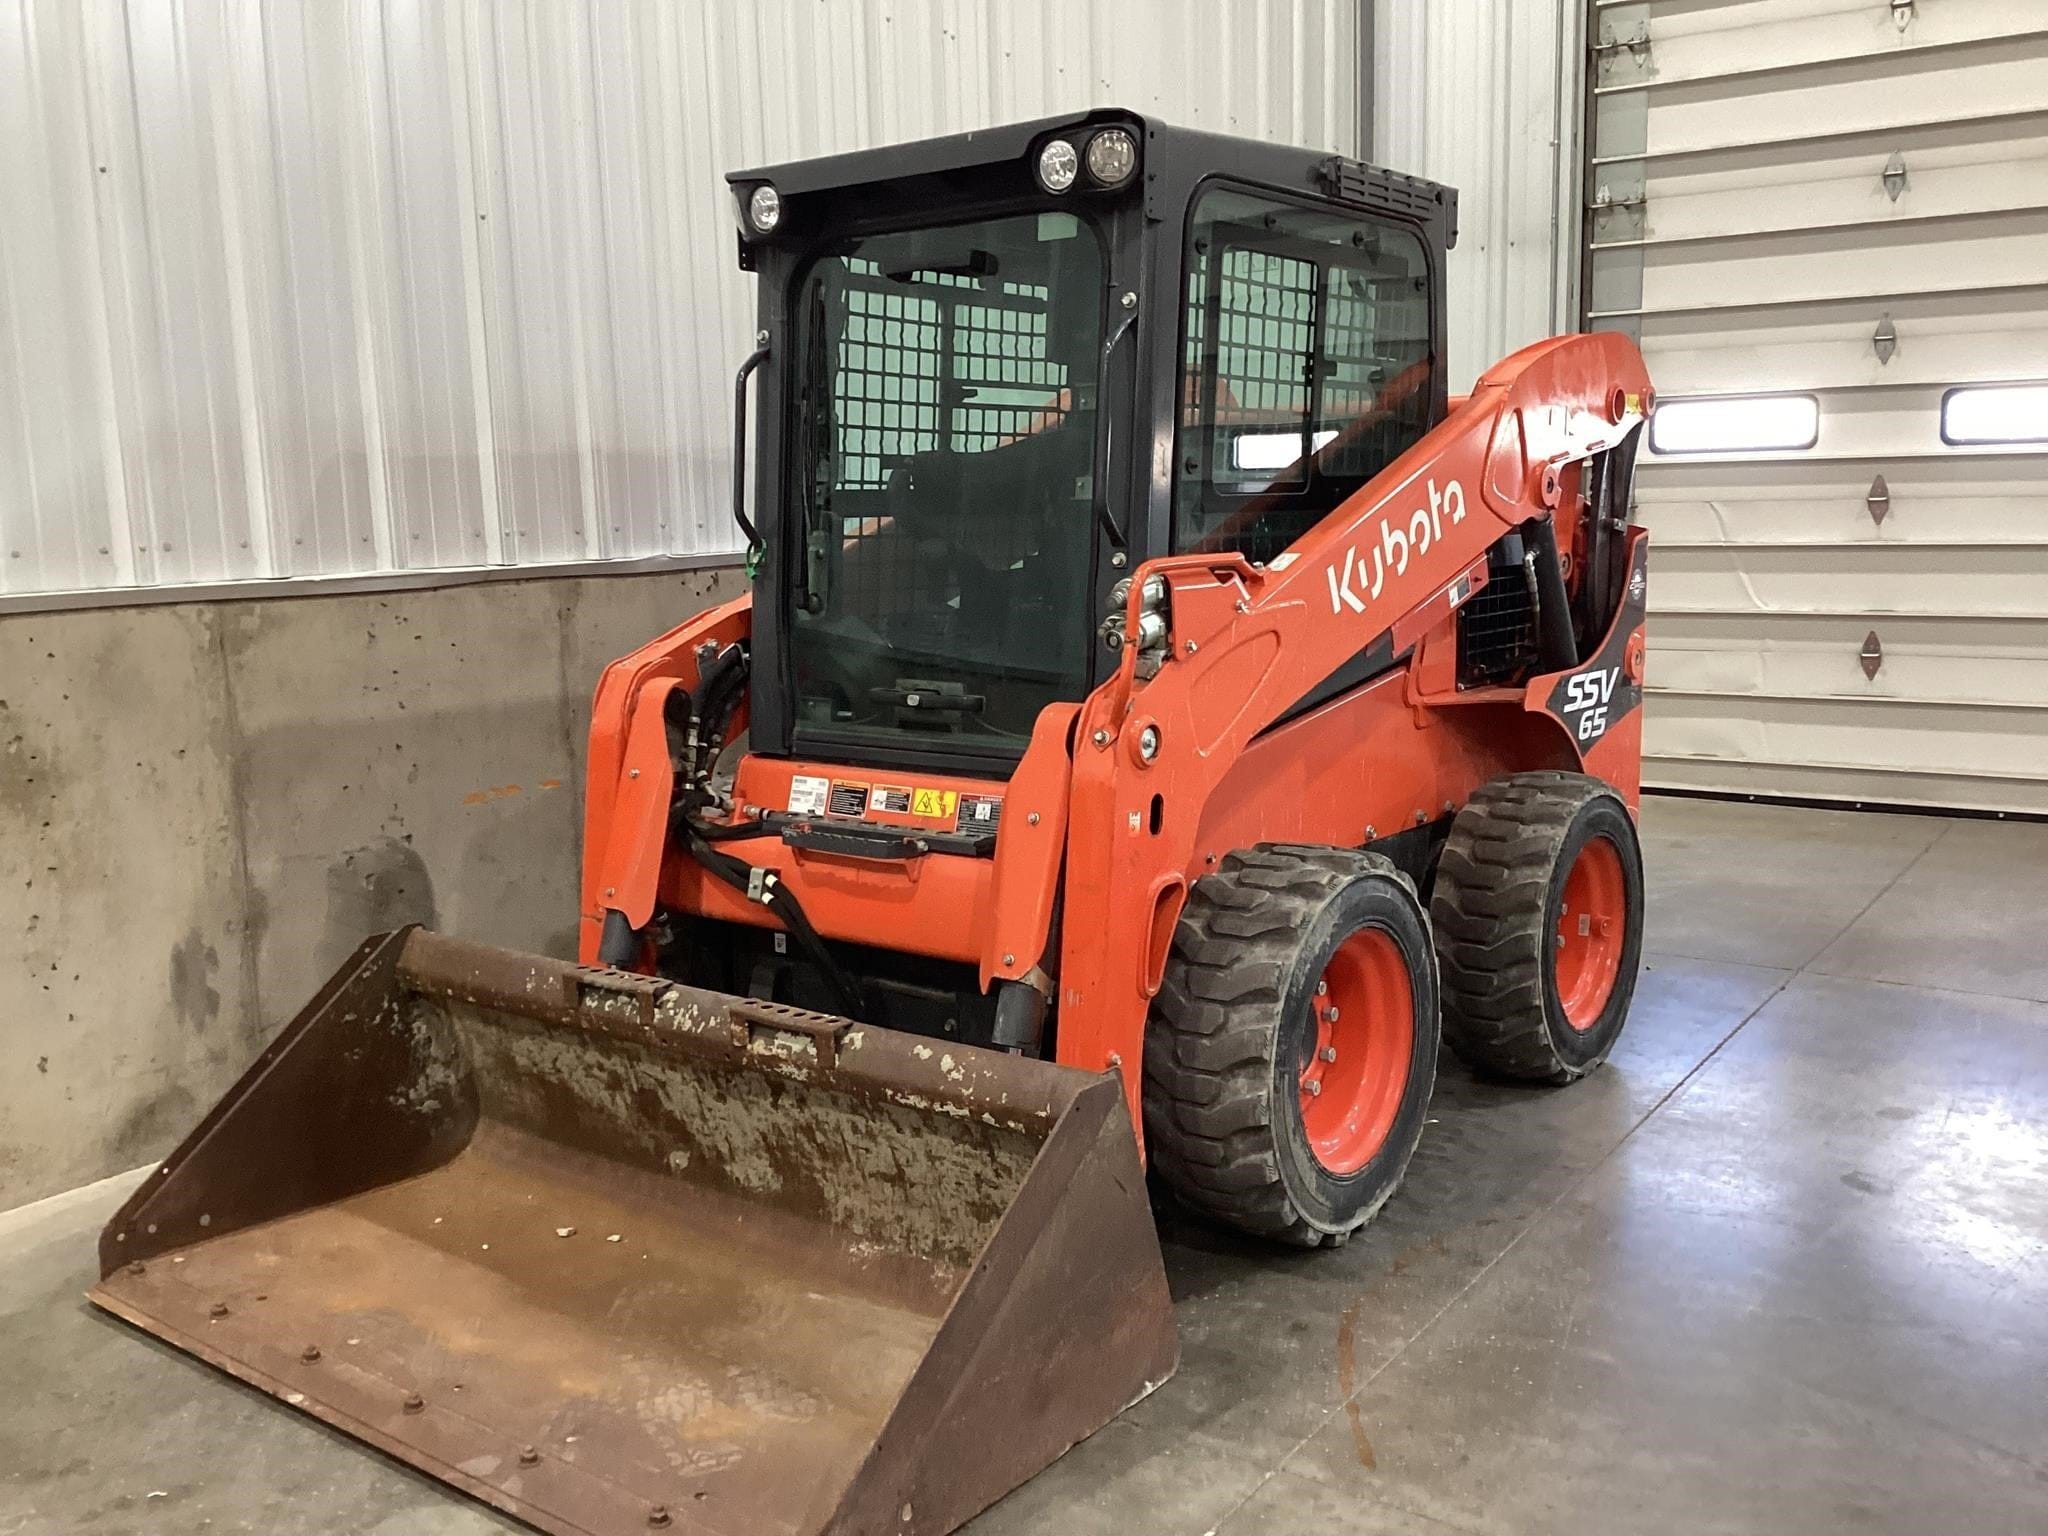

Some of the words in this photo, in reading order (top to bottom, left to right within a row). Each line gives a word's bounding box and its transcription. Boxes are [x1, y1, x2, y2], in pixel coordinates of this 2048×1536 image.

[1327, 478, 1466, 615] Kubota
[1563, 666, 1620, 713] SSV
[1578, 706, 1608, 740] 65
